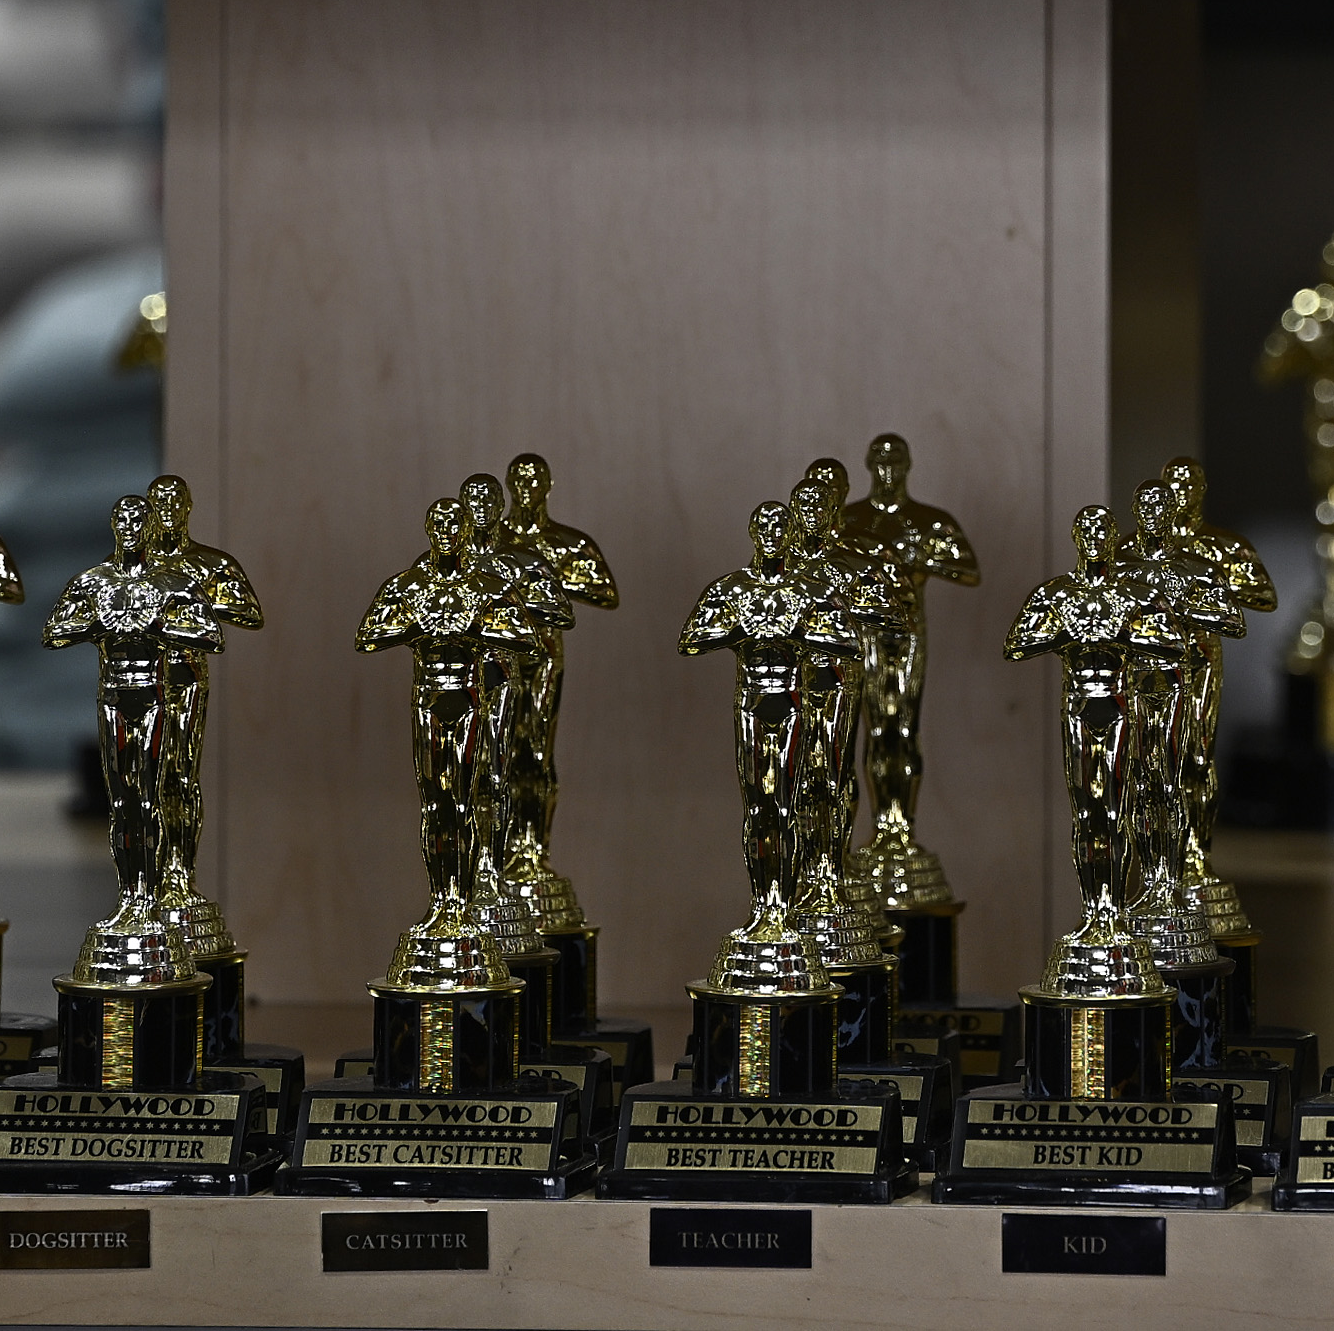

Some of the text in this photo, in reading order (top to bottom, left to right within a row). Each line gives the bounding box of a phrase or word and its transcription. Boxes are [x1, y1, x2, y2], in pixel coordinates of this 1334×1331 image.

[14, 1094, 215, 1116] HOLLYWOOD
[333, 1103, 532, 1124] HOLLYWOOD
[993, 1103, 1192, 1124] HOLLYWOOD
[656, 1105, 858, 1127] HOLLYWOOD
[9, 1136, 204, 1160] BEST DOGSITTER
[328, 1143, 524, 1166] BEST CATSITTER
[1032, 1144, 1143, 1165] BEST KID
[666, 1148, 835, 1170] BEST TEACHER
[9, 1231, 129, 1249] DOGSITTER
[346, 1232, 467, 1250] CATSITTER
[678, 1231, 780, 1249] TEACHER
[1063, 1236, 1107, 1254] KID
